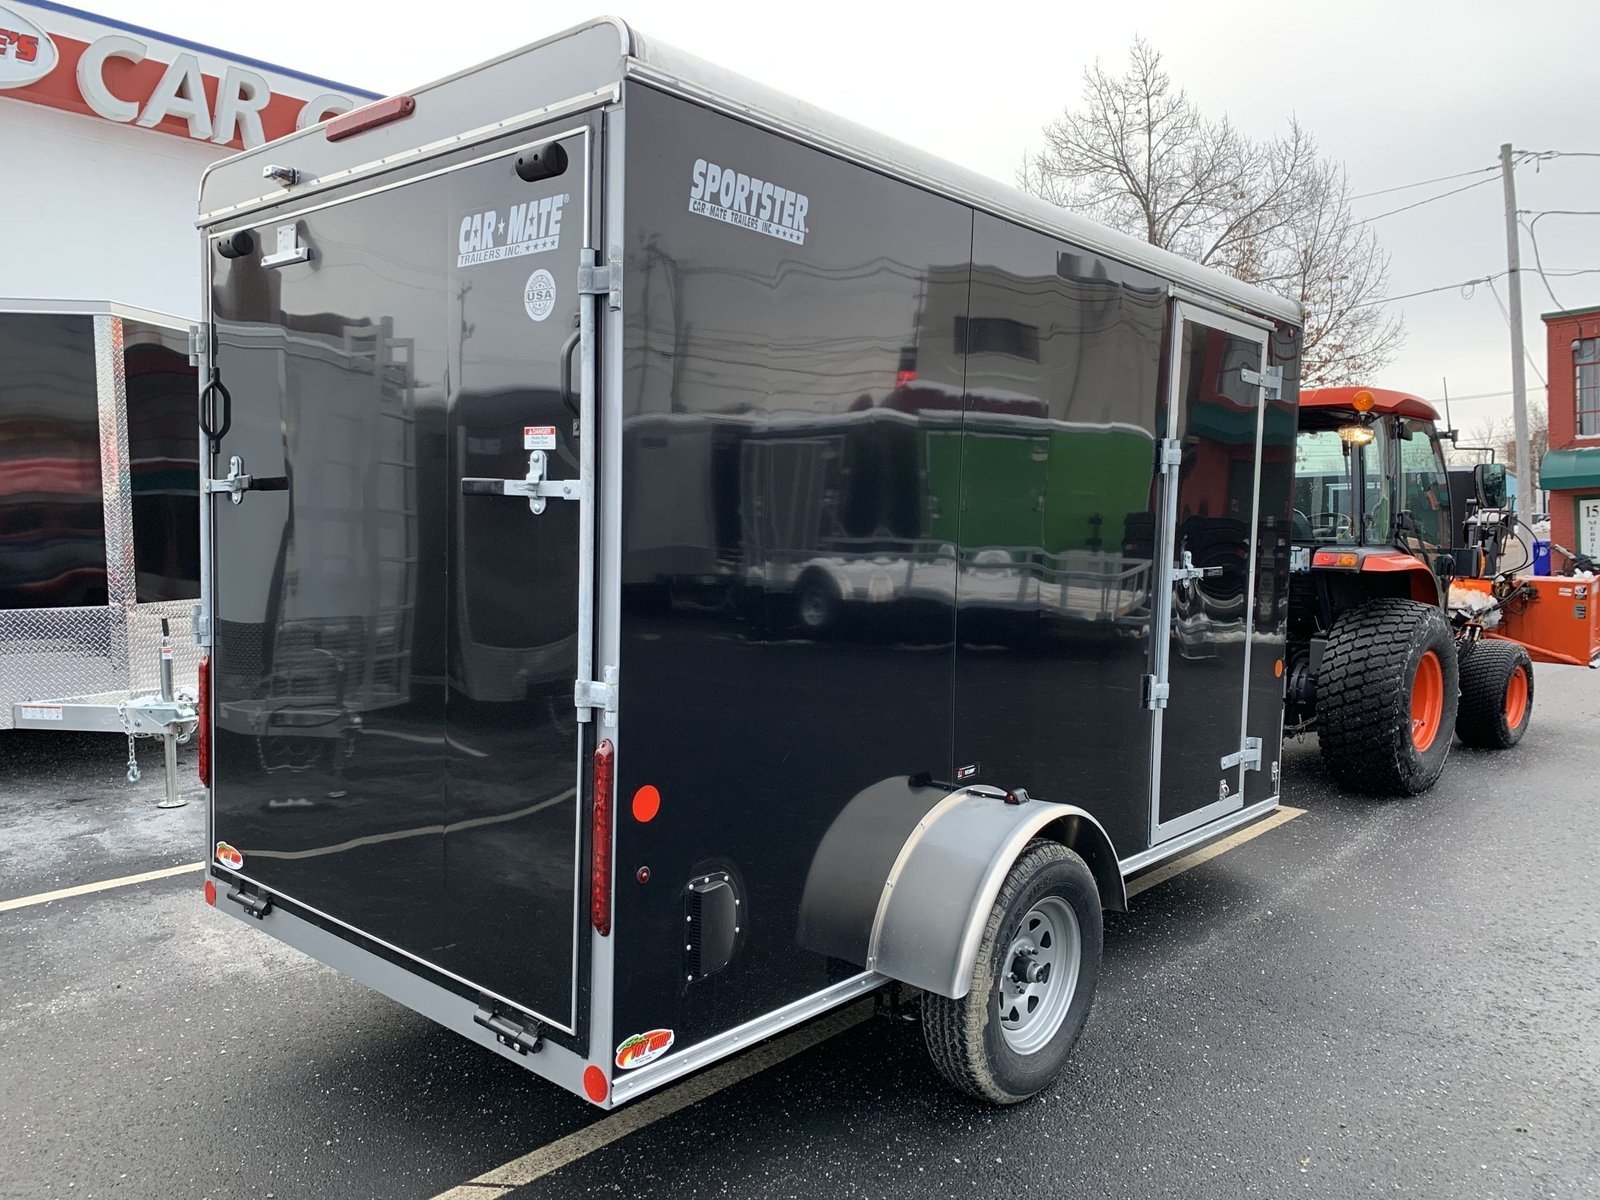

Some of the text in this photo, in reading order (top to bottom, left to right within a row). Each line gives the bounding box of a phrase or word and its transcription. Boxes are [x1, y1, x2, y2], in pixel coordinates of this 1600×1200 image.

[76, 35, 271, 151] CAR
[690, 158, 809, 233] SPORTSTER
[731, 212, 759, 230] TRAILERS
[459, 210, 497, 254] CAR
[460, 245, 522, 265] TRAILERS INC.
[527, 290, 552, 301] USA
[1585, 505, 1599, 518] 15
